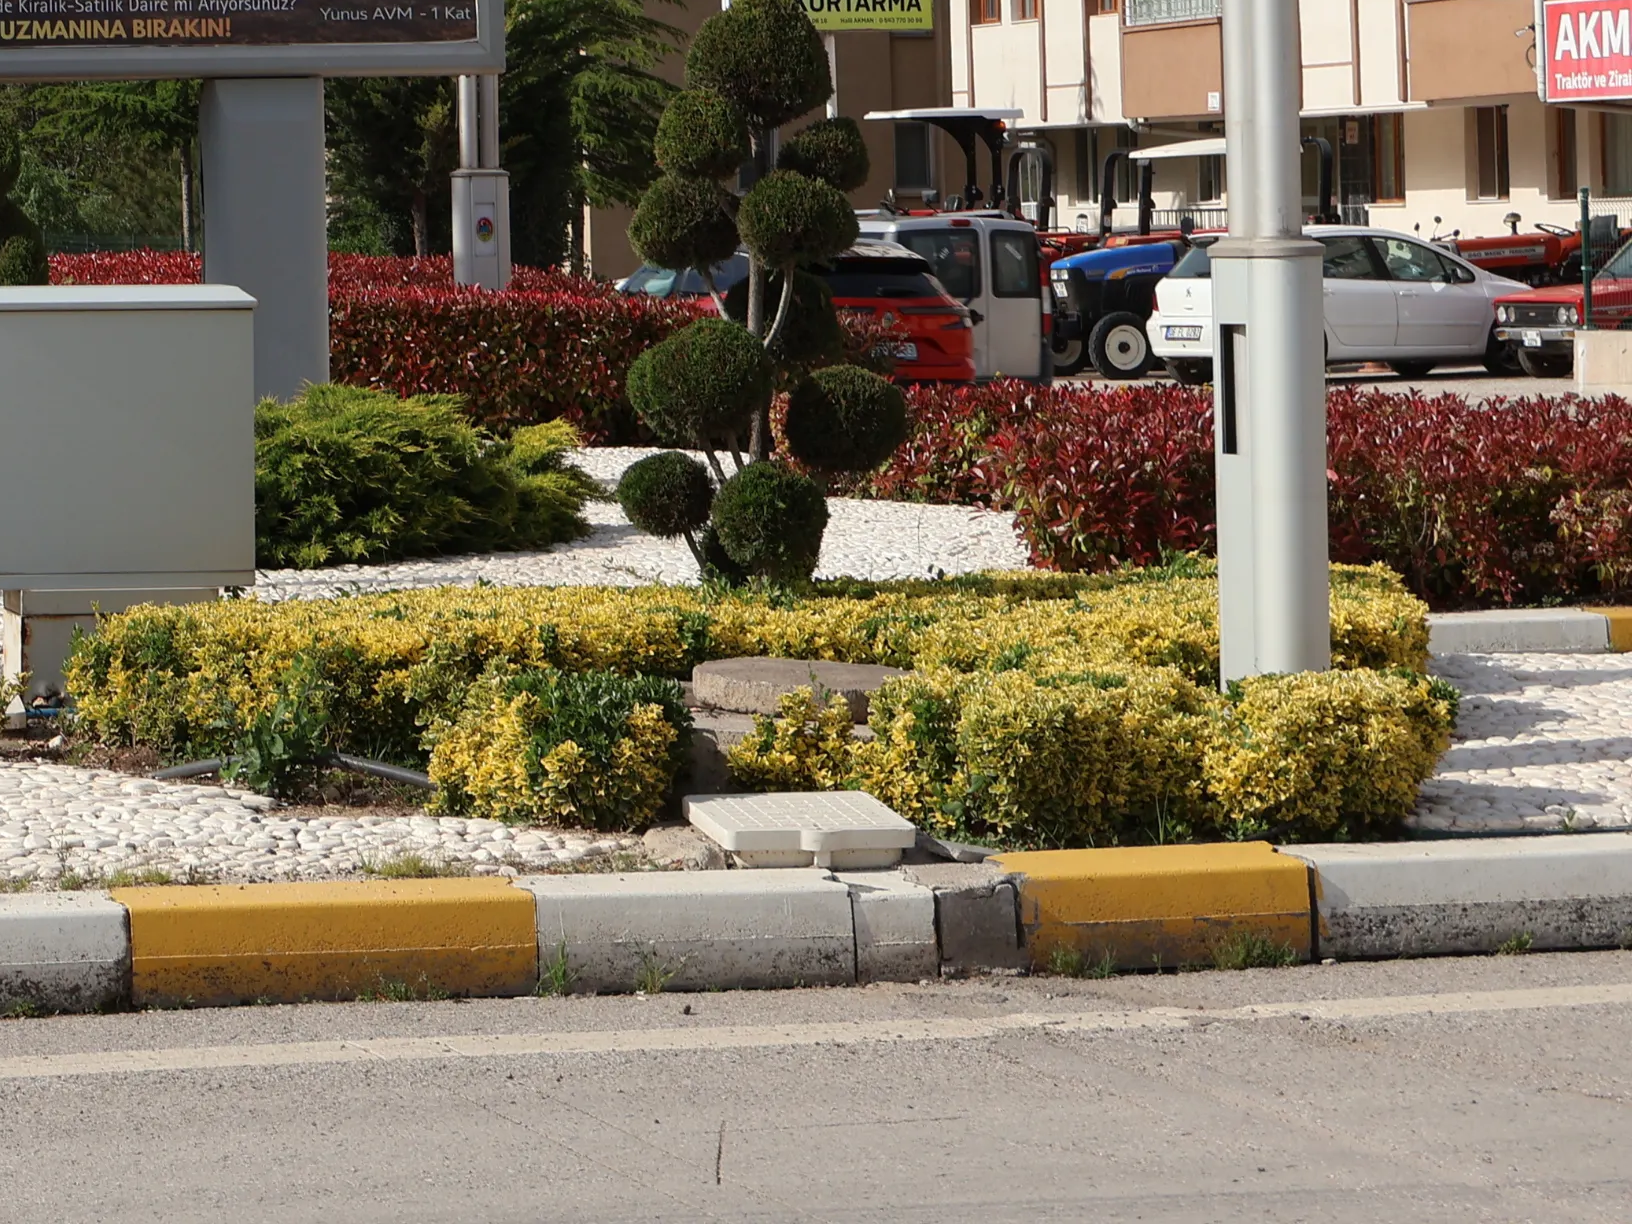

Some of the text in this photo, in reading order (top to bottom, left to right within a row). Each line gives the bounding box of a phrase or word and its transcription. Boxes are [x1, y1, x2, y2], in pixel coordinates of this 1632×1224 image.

[320, 7, 368, 21] Yunus
[372, 6, 413, 20] AVM
[431, 7, 439, 20] 1
[445, 6, 471, 20] Kat
[0, 18, 127, 40] UZMANINA
[132, 18, 232, 39] BIRAKIN!
[1554, 8, 1632, 62] AKM
[1554, 71, 1592, 90] Traktör
[1594, 74, 1607, 88] ve
